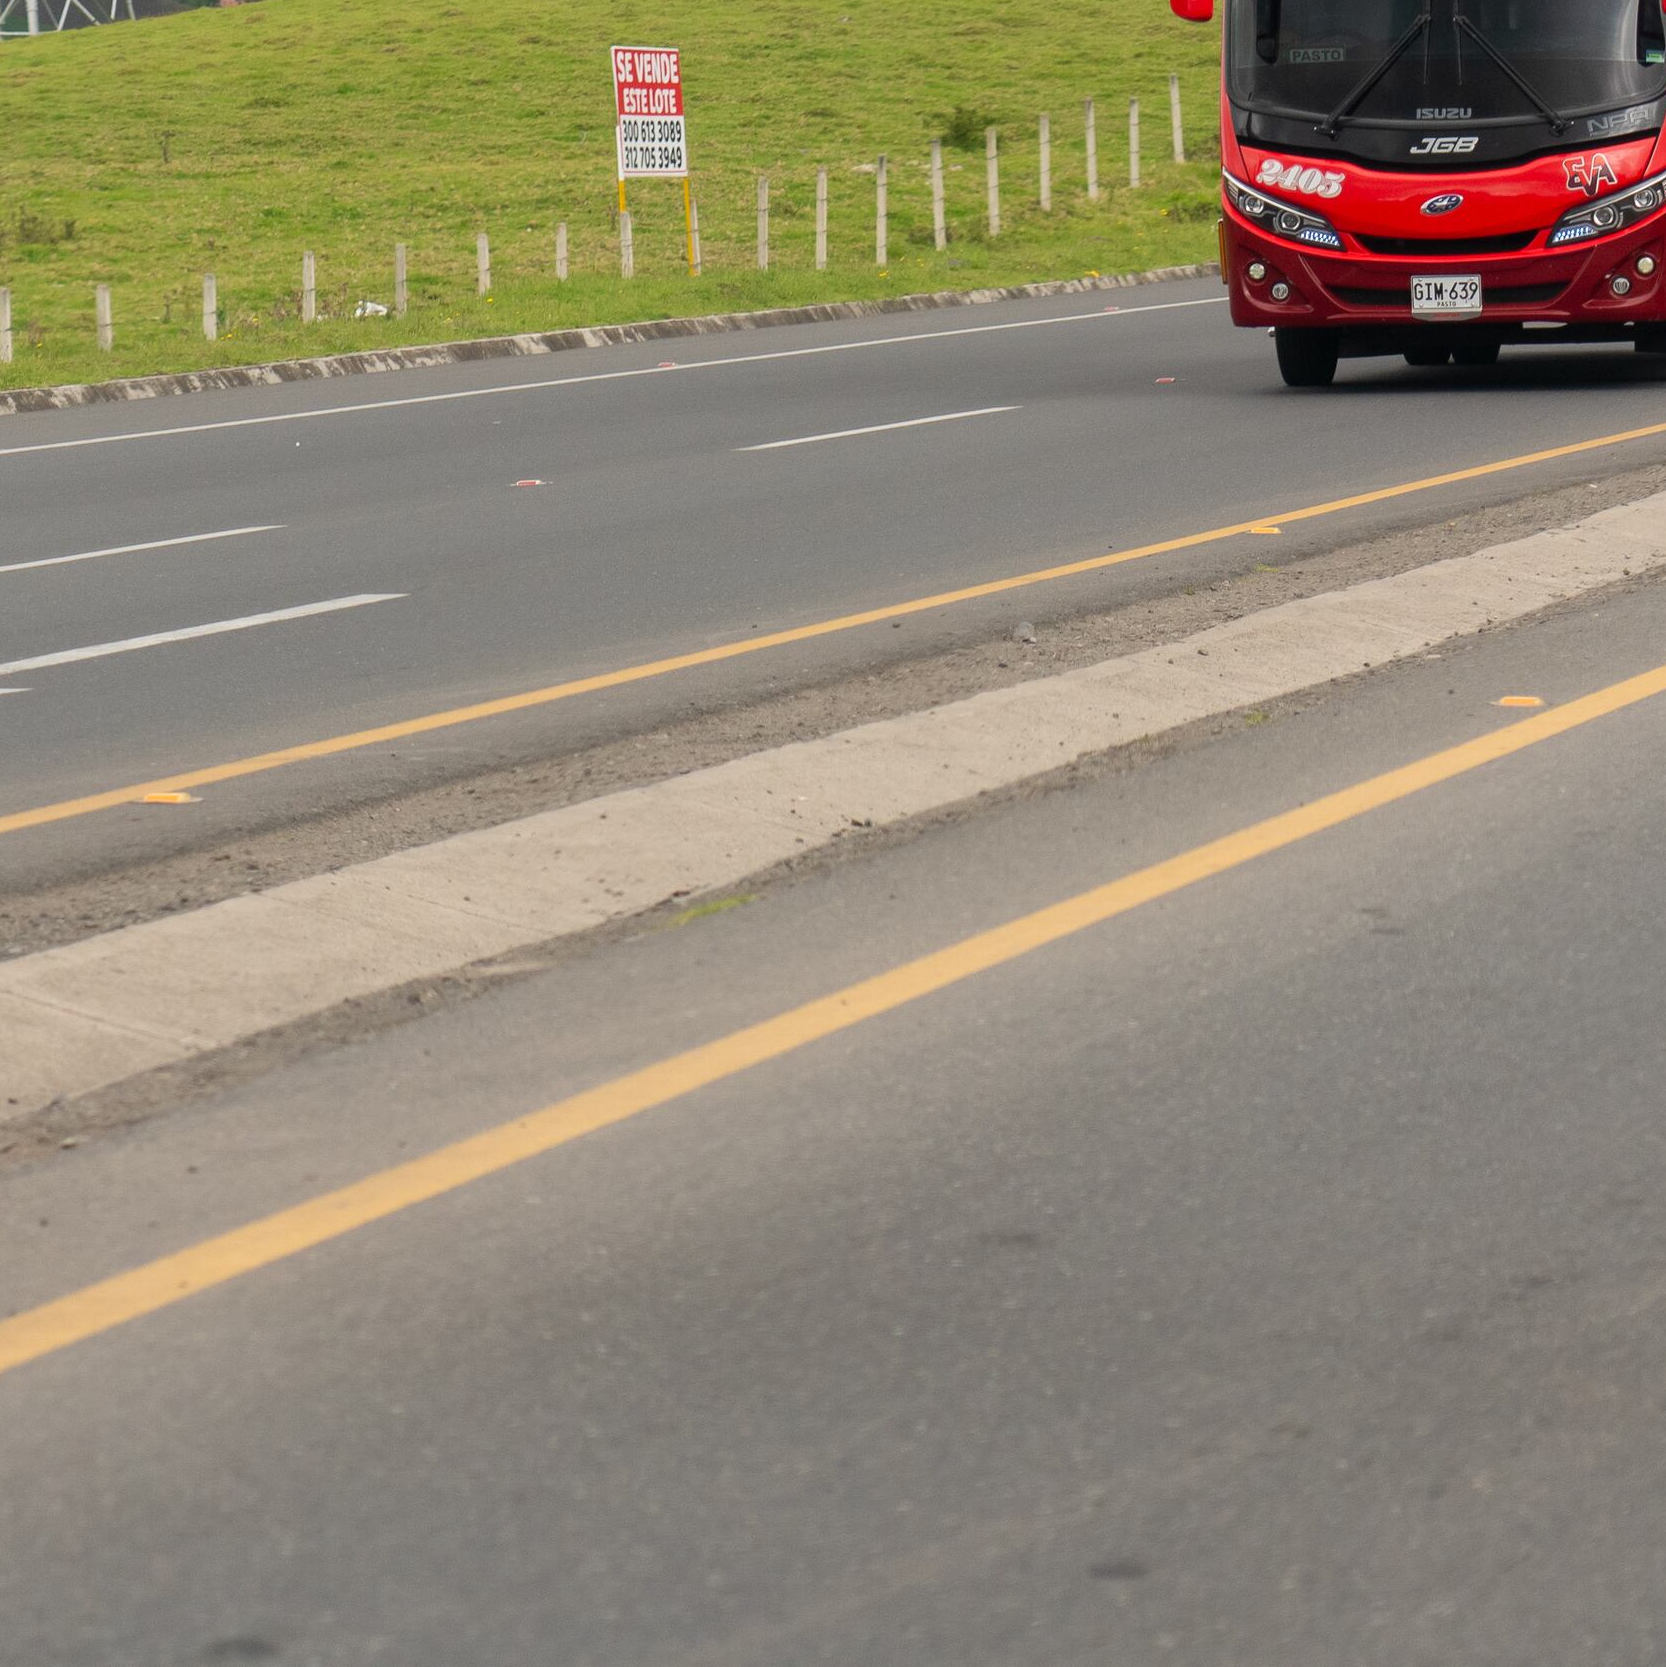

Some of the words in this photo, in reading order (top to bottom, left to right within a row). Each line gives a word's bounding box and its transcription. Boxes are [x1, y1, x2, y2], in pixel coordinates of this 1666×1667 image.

[1291, 49, 1342, 62] PASTO
[616, 51, 634, 83] SE
[634, 52, 679, 84] VENDE
[623, 88, 648, 113] ESTE
[649, 88, 677, 114] LOTE
[1416, 108, 1472, 119] ISUZU
[623, 120, 639, 143] 300
[640, 120, 656, 143] 613
[658, 120, 682, 143] 3089
[1410, 137, 1479, 154] JGB
[625, 146, 638, 169] 312
[639, 147, 656, 169] 705
[658, 146, 682, 169] 3949
[1255, 159, 1345, 199] 2405
[1563, 153, 1618, 197] EVA
